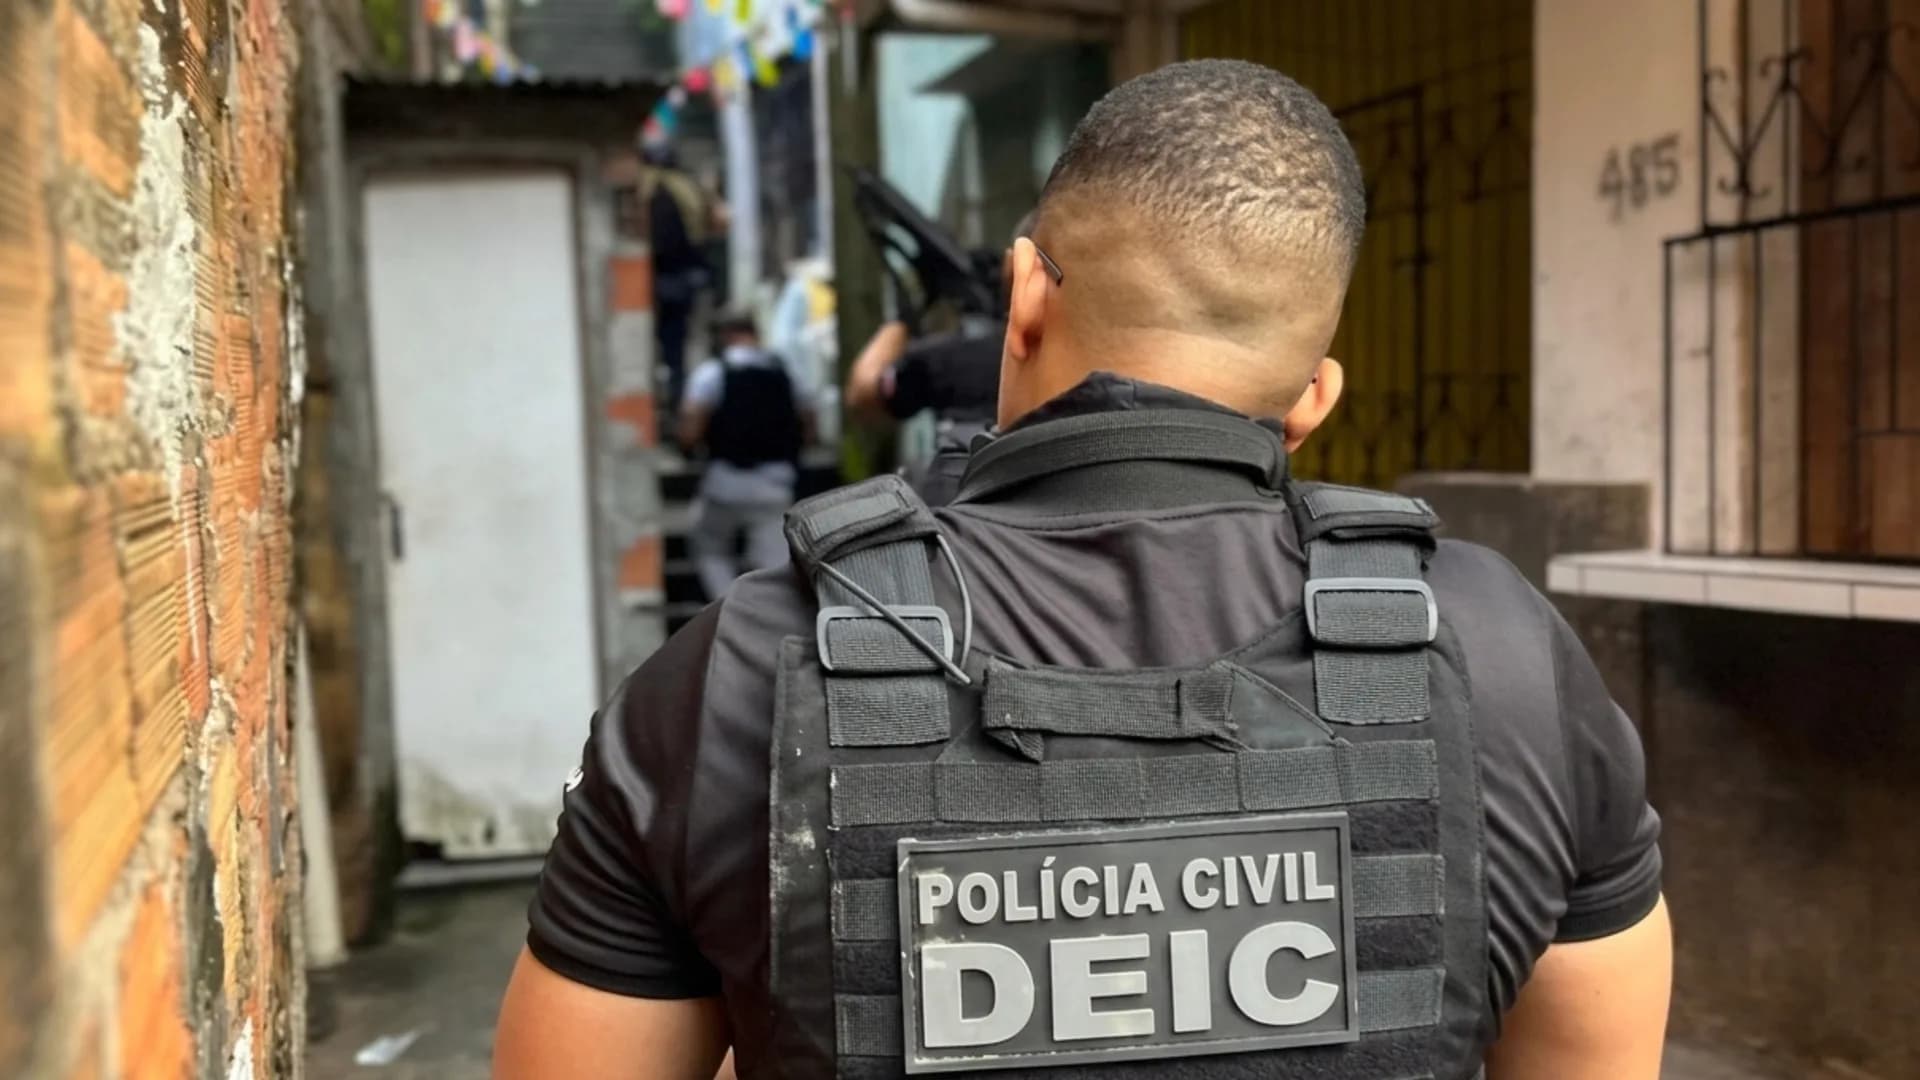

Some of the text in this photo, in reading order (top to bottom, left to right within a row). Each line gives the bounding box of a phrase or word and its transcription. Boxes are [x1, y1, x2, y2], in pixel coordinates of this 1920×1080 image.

[917, 851, 1335, 925] POLÍCIA CIVIL
[920, 920, 1340, 1048] DEIC
